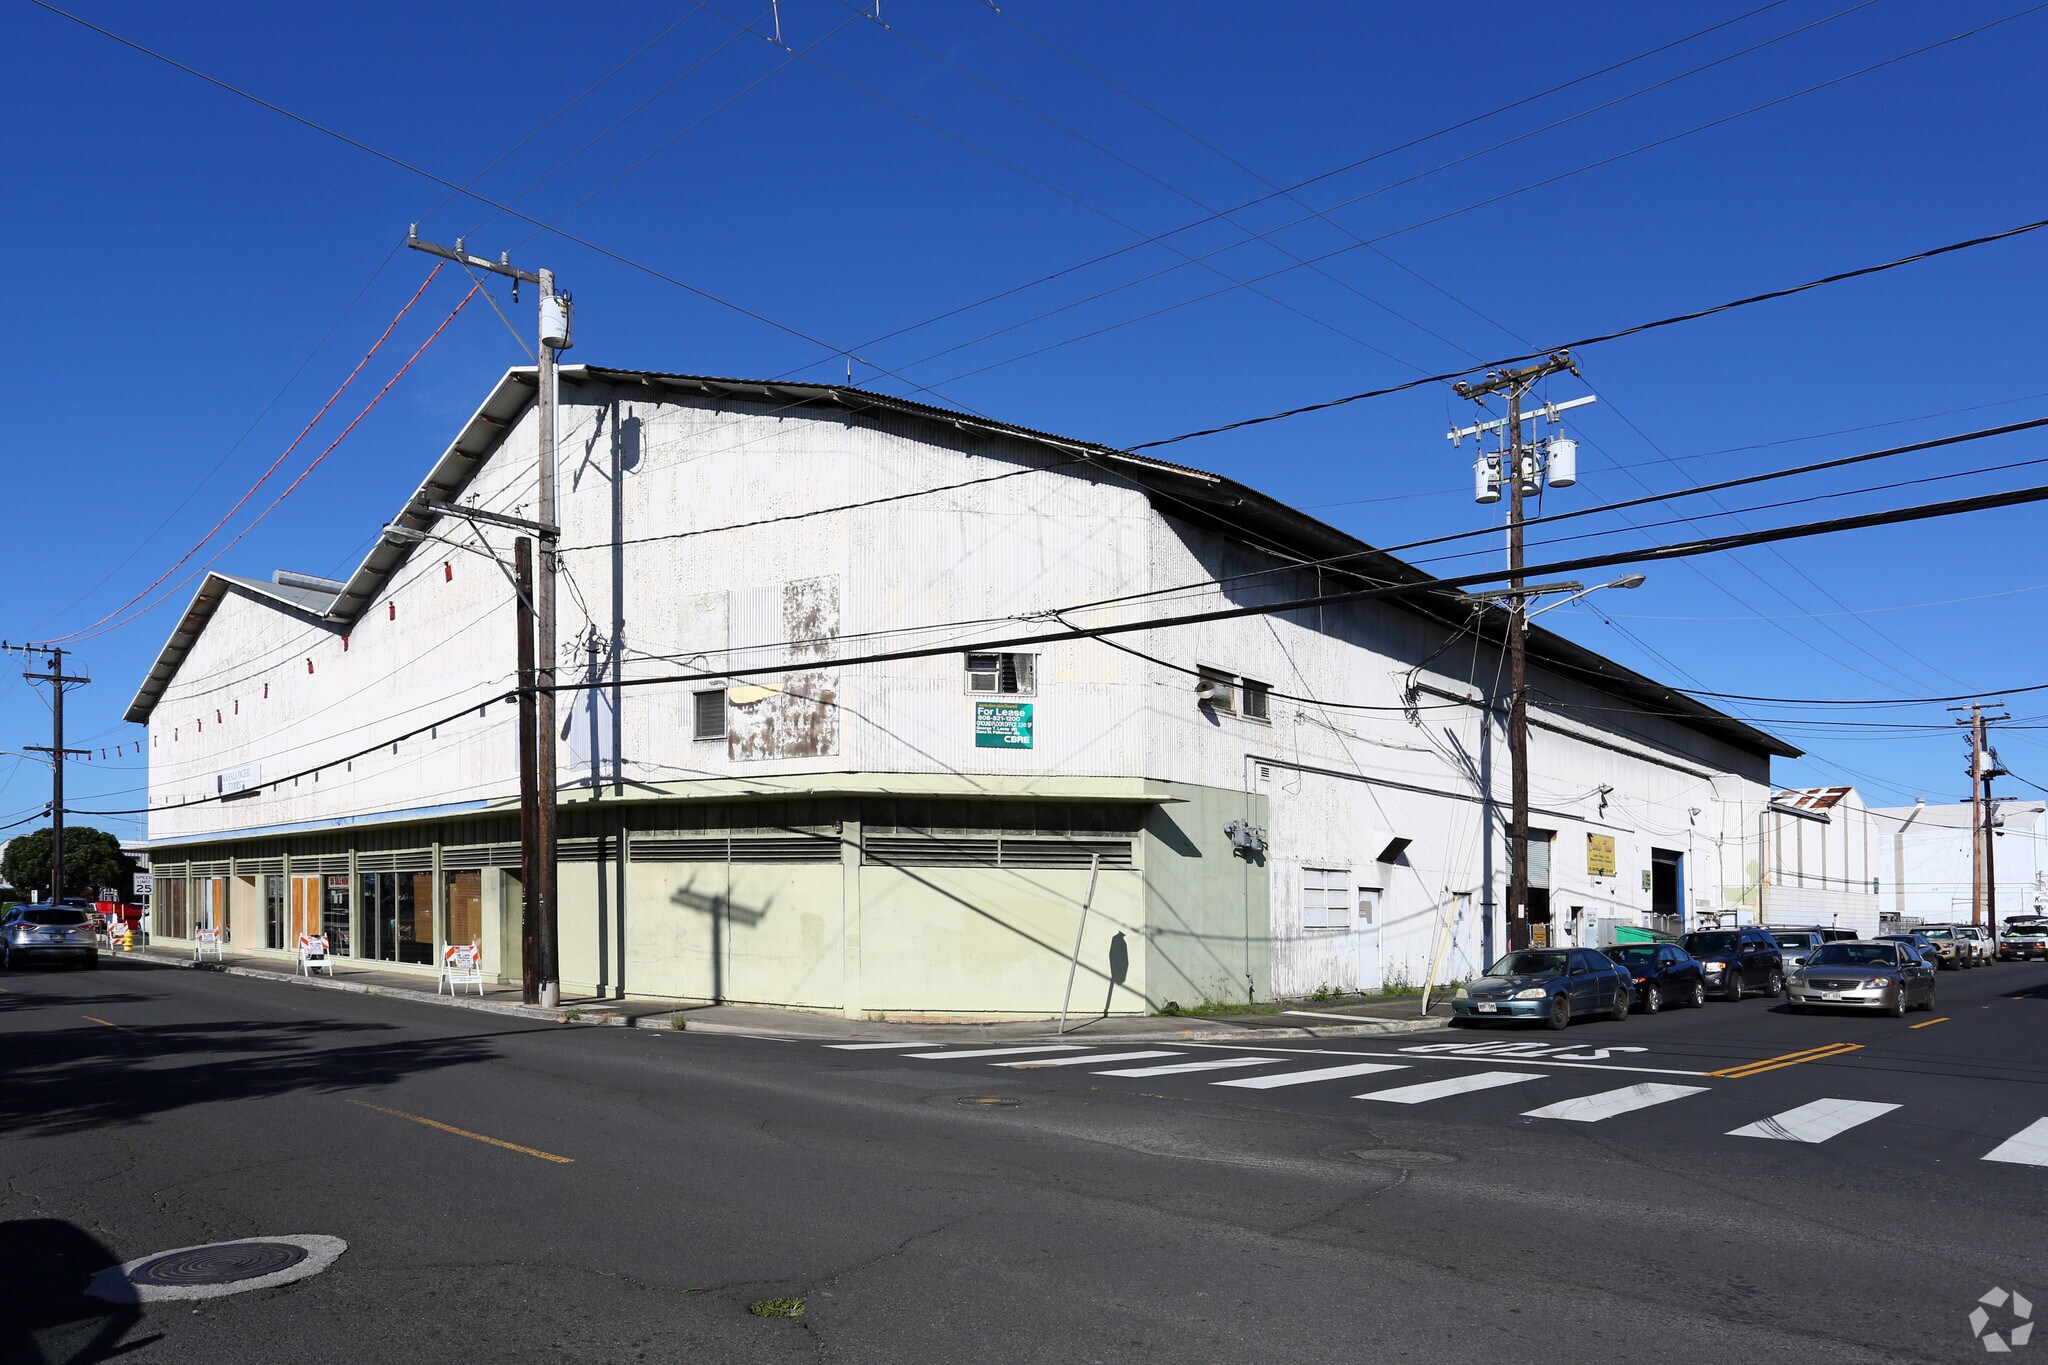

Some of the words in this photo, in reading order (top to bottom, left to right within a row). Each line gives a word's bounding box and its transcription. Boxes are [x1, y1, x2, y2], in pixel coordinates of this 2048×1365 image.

[977, 707, 994, 715] For
[996, 708, 1026, 717] Lease
[1004, 736, 1030, 744] CBRE
[136, 884, 152, 893] 25
